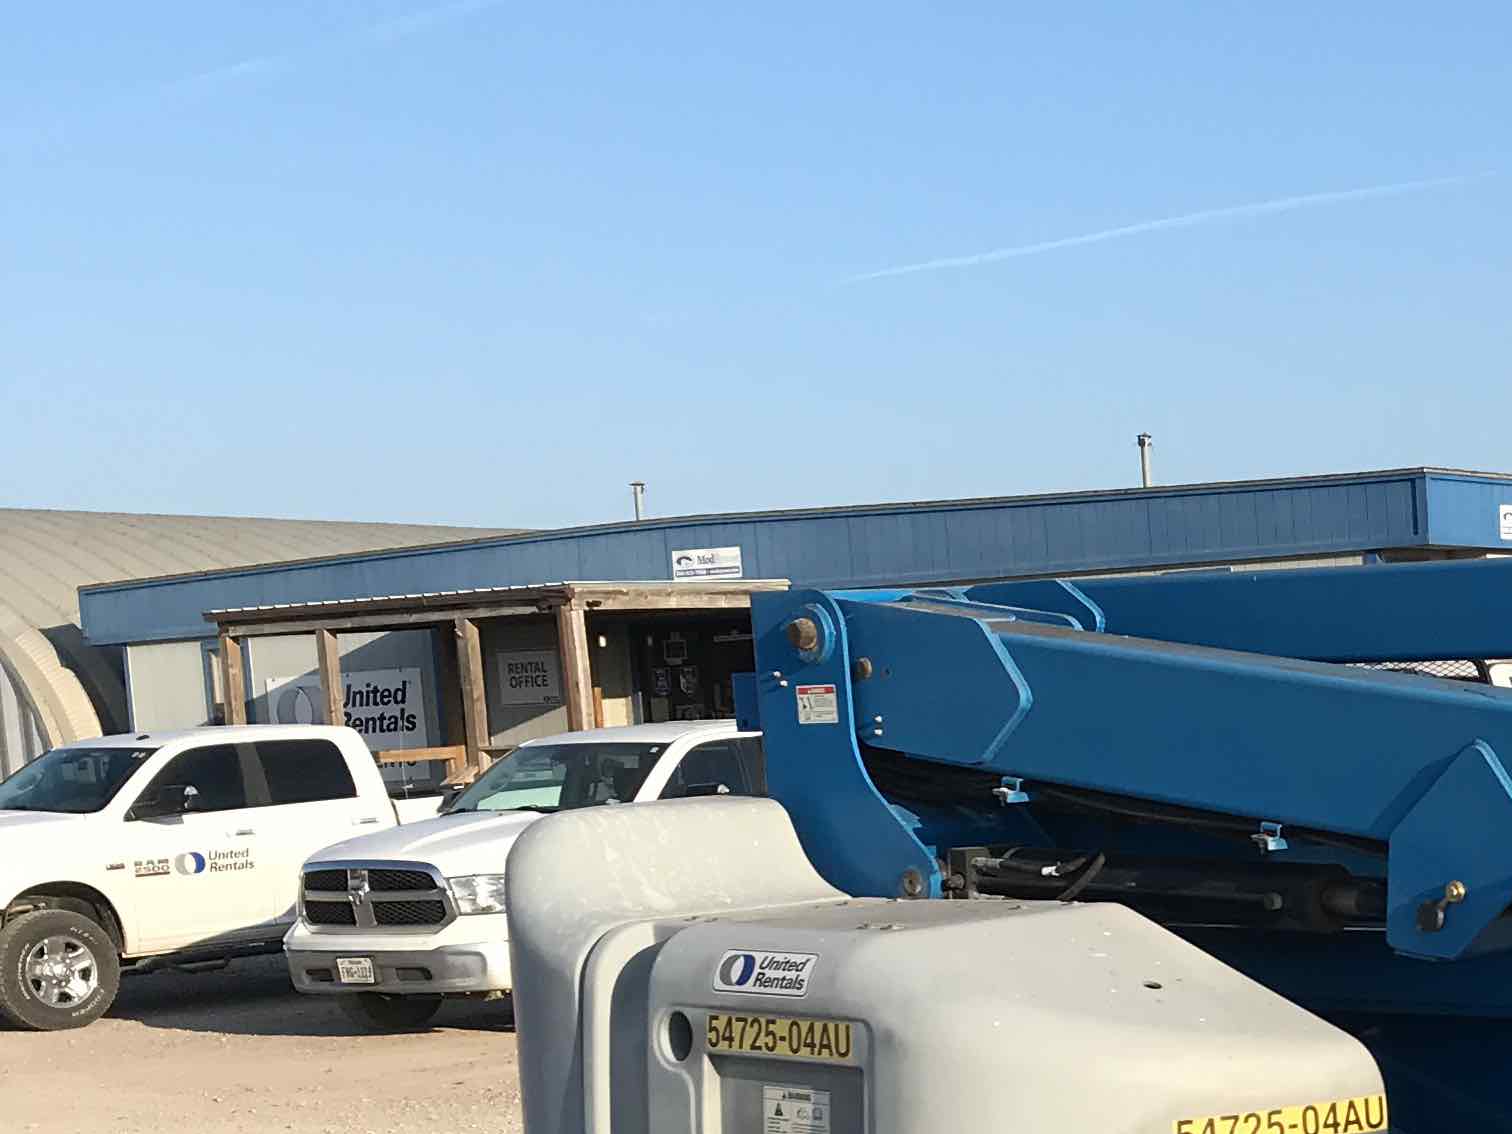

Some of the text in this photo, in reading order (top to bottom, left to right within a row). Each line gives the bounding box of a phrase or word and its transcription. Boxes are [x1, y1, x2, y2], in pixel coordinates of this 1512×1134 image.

[508, 661, 548, 674] RENTAL
[510, 675, 549, 688] OFFICE
[208, 848, 249, 861] United
[209, 859, 255, 873] Rentals
[759, 956, 811, 972] United
[753, 972, 806, 990] Rentals
[707, 1015, 851, 1058] 54725-04AU
